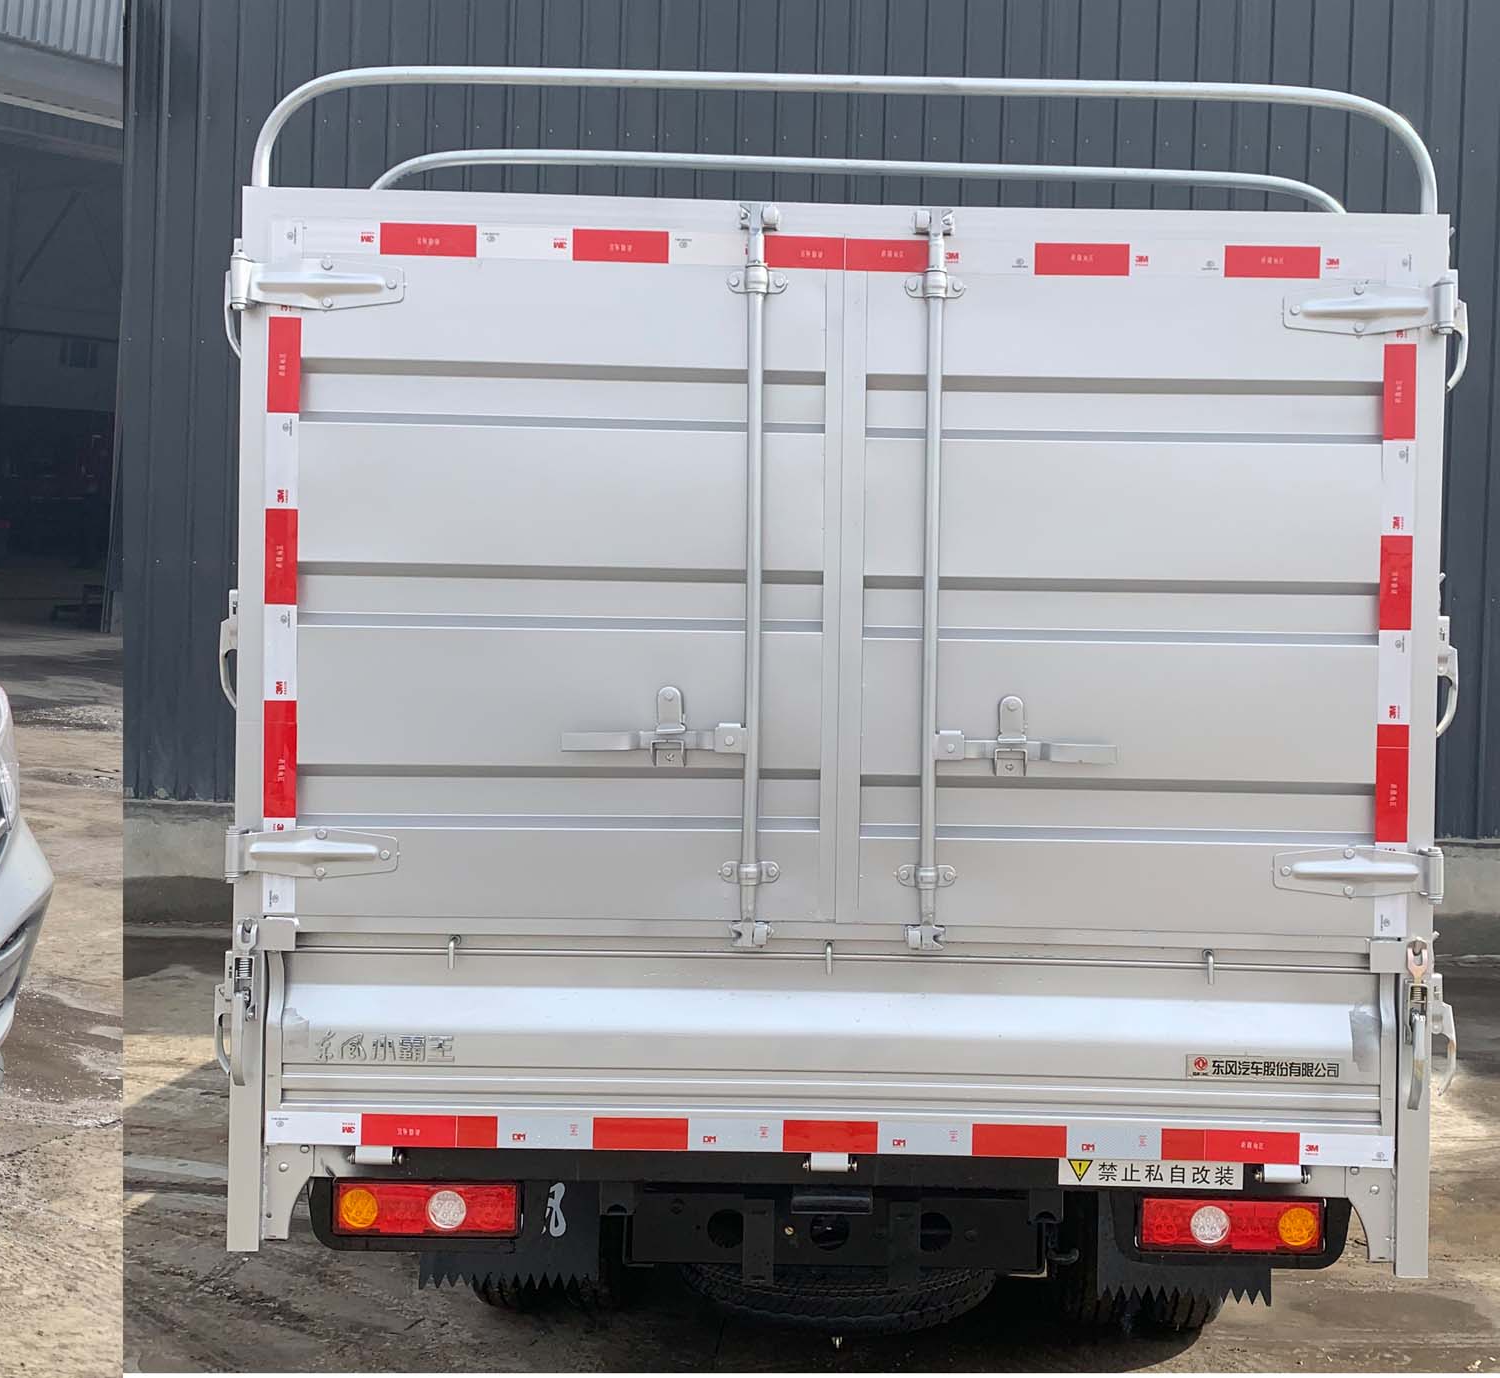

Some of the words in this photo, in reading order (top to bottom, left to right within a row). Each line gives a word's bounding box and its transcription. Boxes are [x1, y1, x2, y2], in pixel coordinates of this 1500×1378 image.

[360, 234, 374, 243] 3M
[554, 241, 567, 250] 3M
[945, 252, 959, 261] 3M
[1135, 255, 1149, 263] 3M
[1326, 259, 1339, 267] 3M
[277, 489, 285, 503] 3M
[1392, 516, 1401, 530] 3M
[275, 681, 284, 694] 3M
[1388, 705, 1397, 719] 3M
[1211, 1059, 1340, 1078] 东风汽车股份有限公司
[342, 1126, 356, 1134] 3M
[512, 1133, 526, 1141] DM
[703, 1135, 717, 1144] DM
[892, 1139, 906, 1147] DM
[1081, 1143, 1095, 1152] DM
[1305, 1144, 1319, 1153] 3M
[1097, 1160, 1235, 1186] 禁止私自改装
